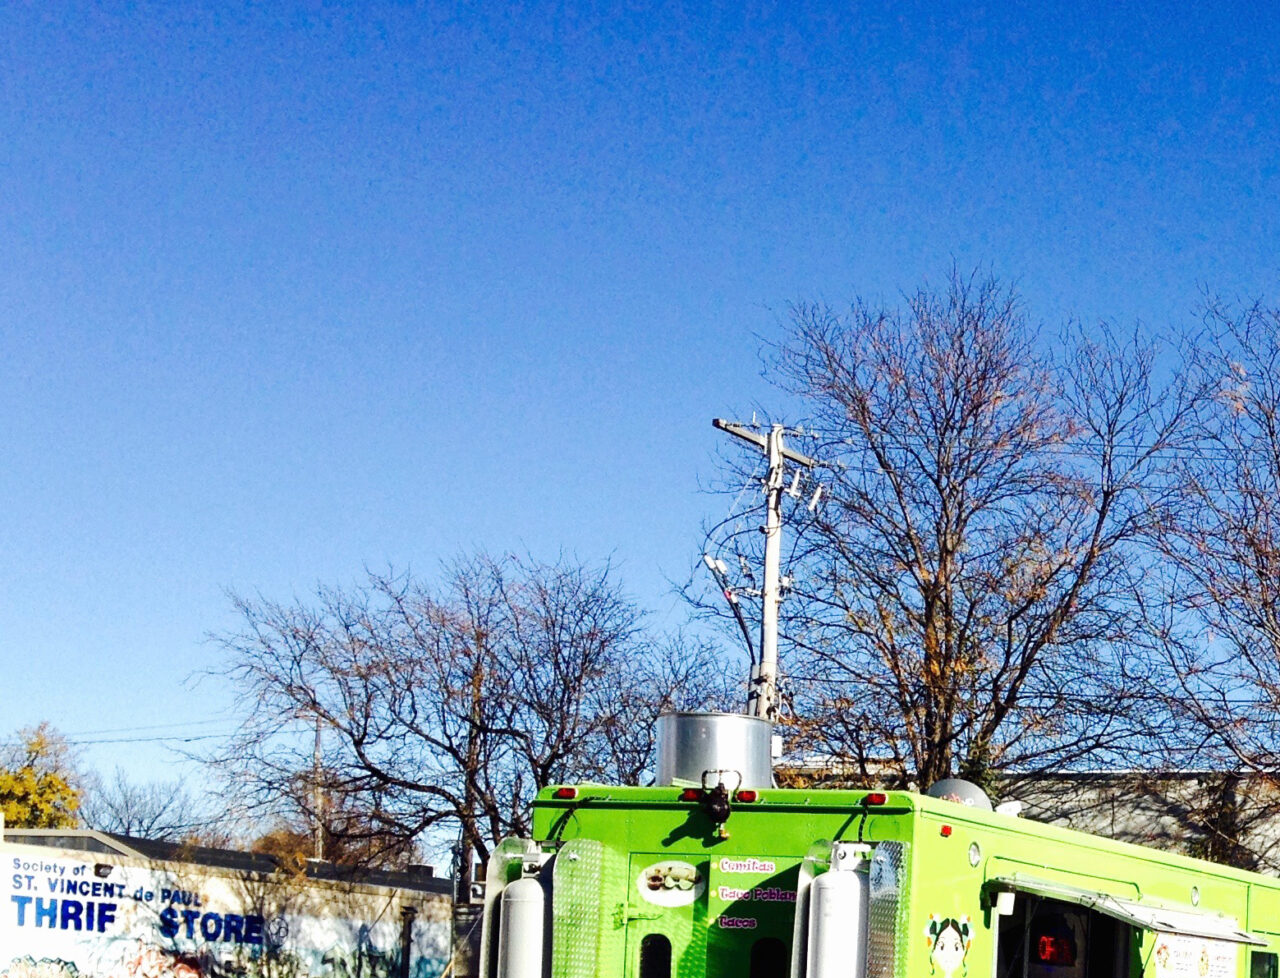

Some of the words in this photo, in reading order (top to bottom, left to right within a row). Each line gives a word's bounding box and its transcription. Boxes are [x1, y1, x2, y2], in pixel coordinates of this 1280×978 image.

[13, 858, 66, 876] Society
[72, 864, 86, 876] of
[12, 874, 39, 892] ST.
[48, 877, 126, 899] VINCENT
[133, 886, 154, 902] de
[160, 888, 202, 907] PAUL
[753, 886, 797, 902] Poblan
[158, 903, 265, 945] STORE
